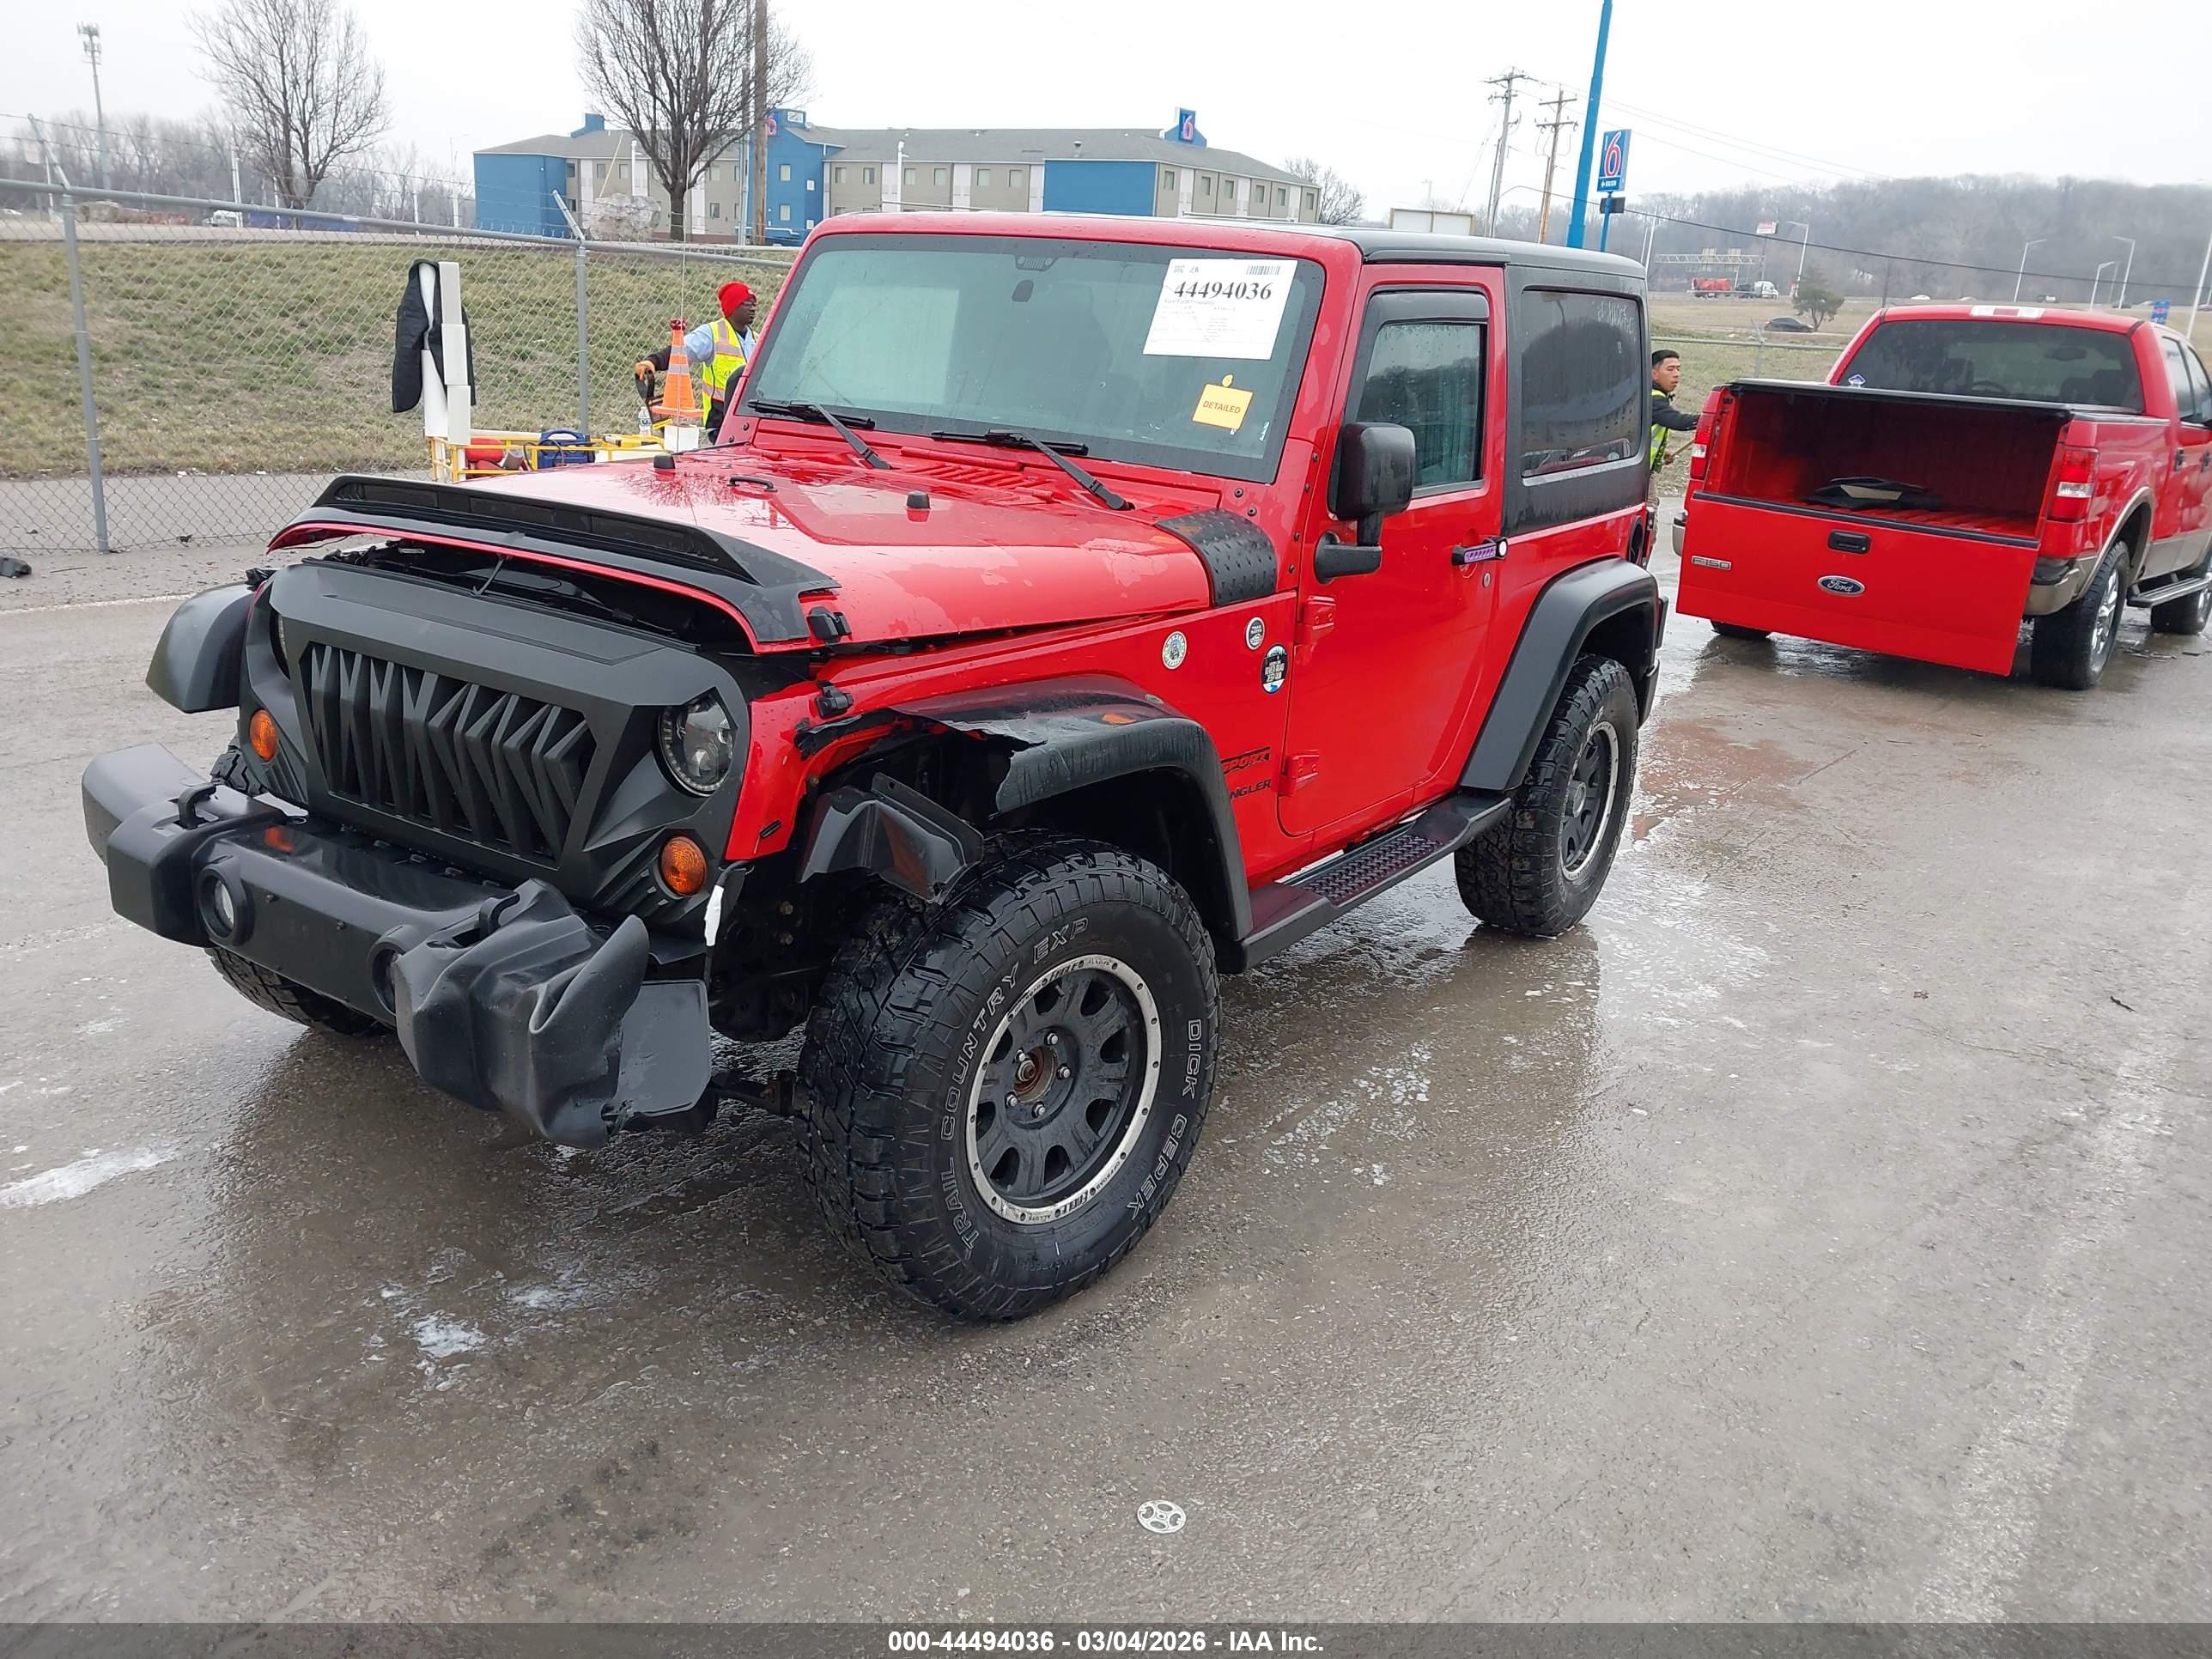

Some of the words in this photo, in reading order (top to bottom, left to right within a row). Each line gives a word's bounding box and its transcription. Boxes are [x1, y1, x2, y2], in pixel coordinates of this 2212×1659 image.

[1183, 115, 1193, 139] 6
[1604, 131, 1622, 179] 6
[1174, 282, 1274, 301] 44494036
[1203, 400, 1241, 414] DETAILED
[1826, 578, 1855, 593] Ford
[1230, 779, 1271, 799] NGLER
[1032, 916, 1090, 965] EXP
[941, 961, 1021, 1142] COUNTRY
[1181, 1018, 1202, 1100] DICK
[1125, 1112, 1188, 1221] CEPEK
[940, 1156, 981, 1252] TRAIL
